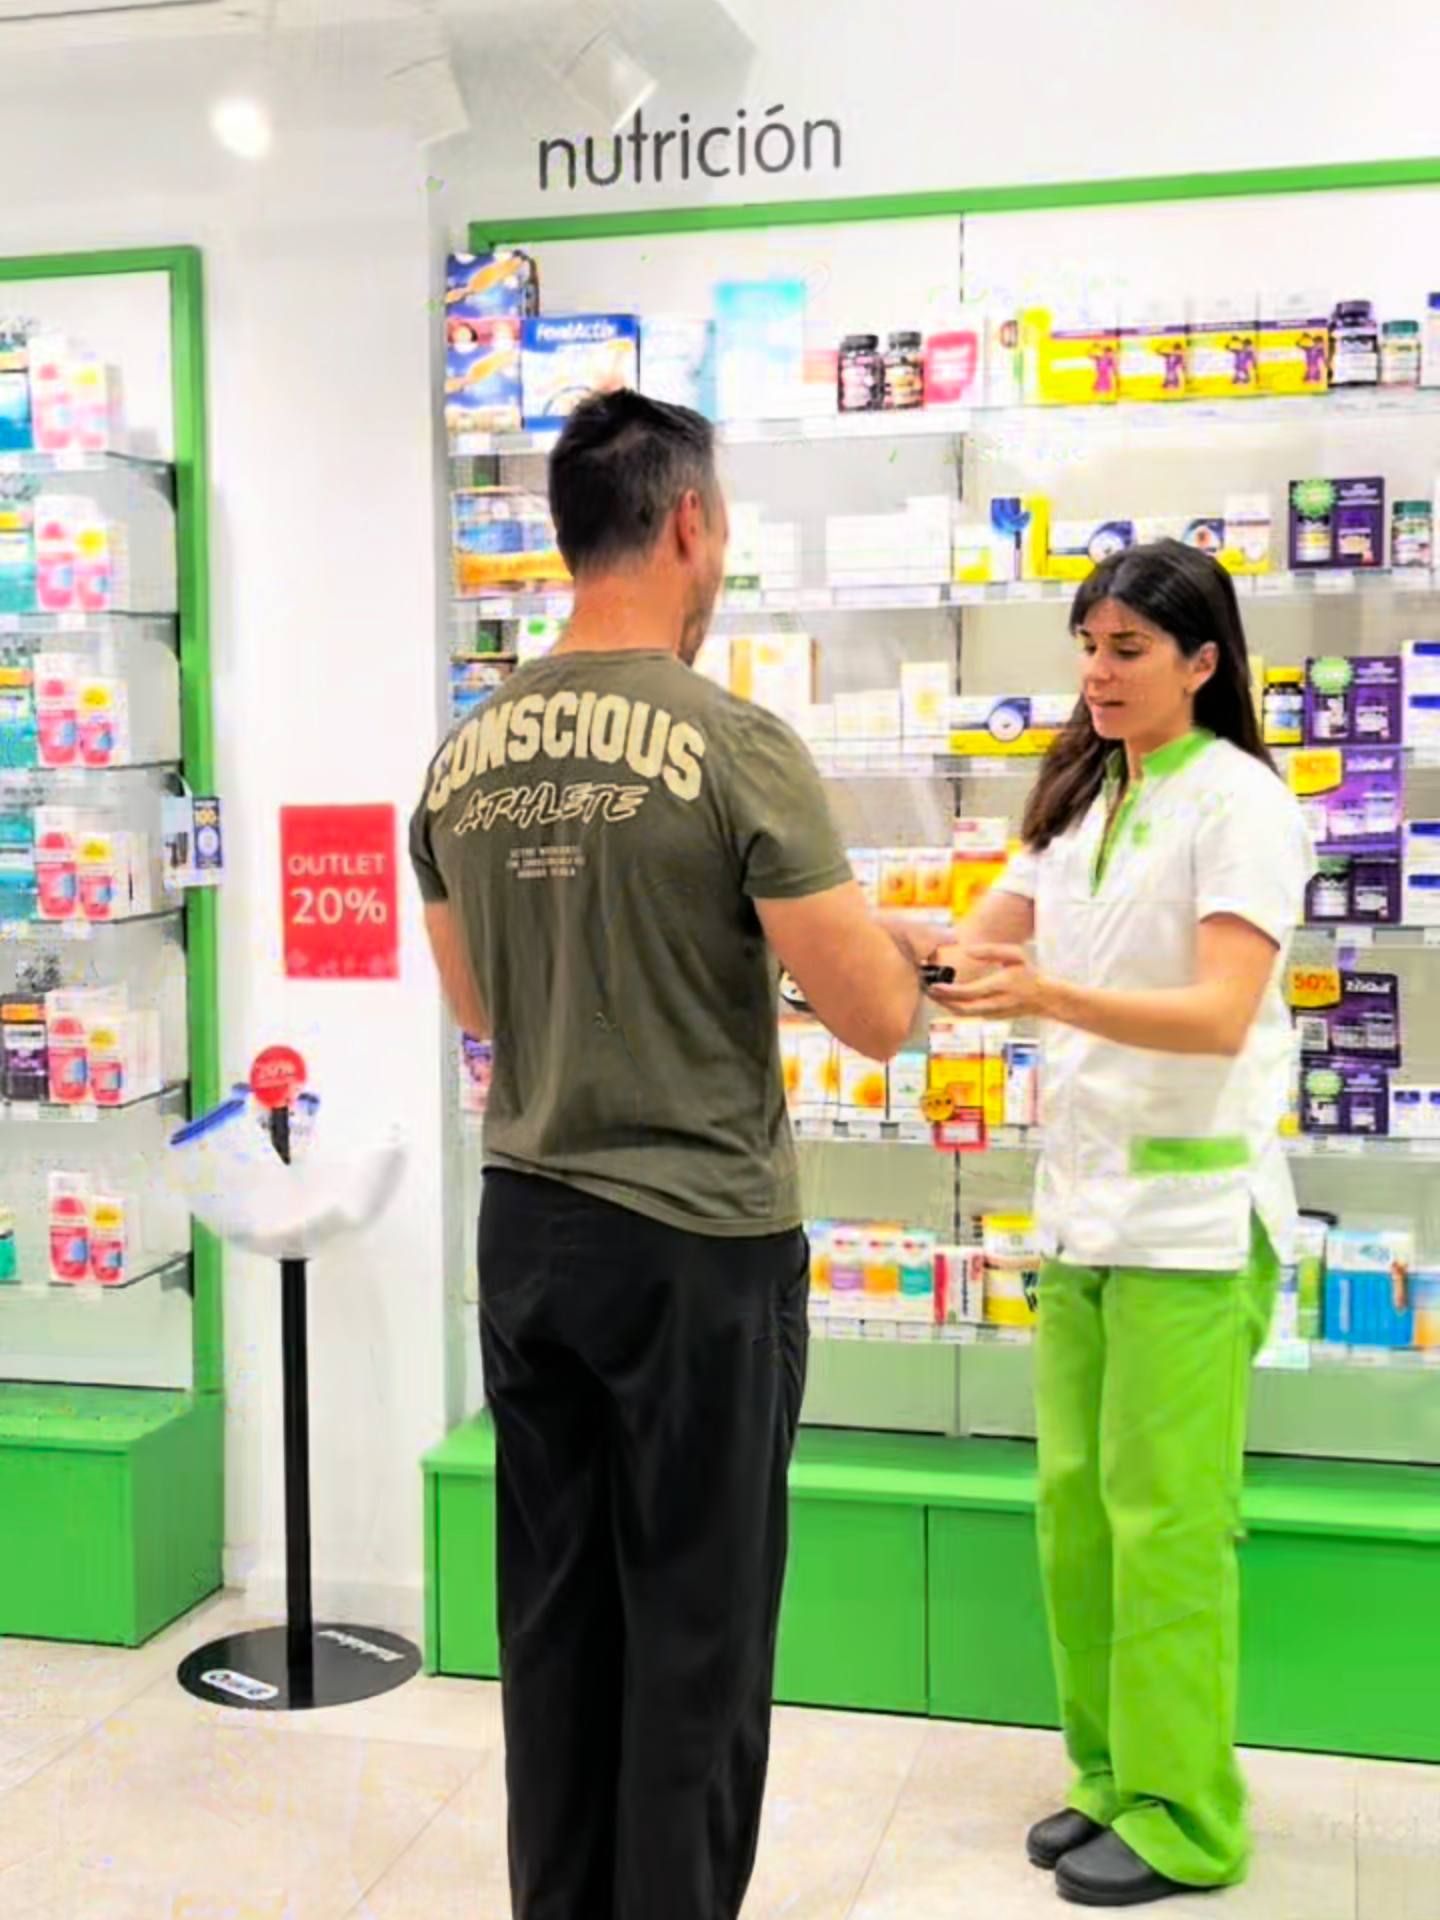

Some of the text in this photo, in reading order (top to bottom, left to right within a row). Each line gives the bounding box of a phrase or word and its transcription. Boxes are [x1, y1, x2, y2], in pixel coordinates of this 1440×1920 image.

[539, 104, 842, 191] nutrición
[427, 691, 706, 812] CONSCIOUS
[453, 781, 650, 837] ATHLETE
[288, 853, 385, 877] OUTLET
[292, 887, 388, 925] 20%
[1293, 972, 1336, 992] 50%
